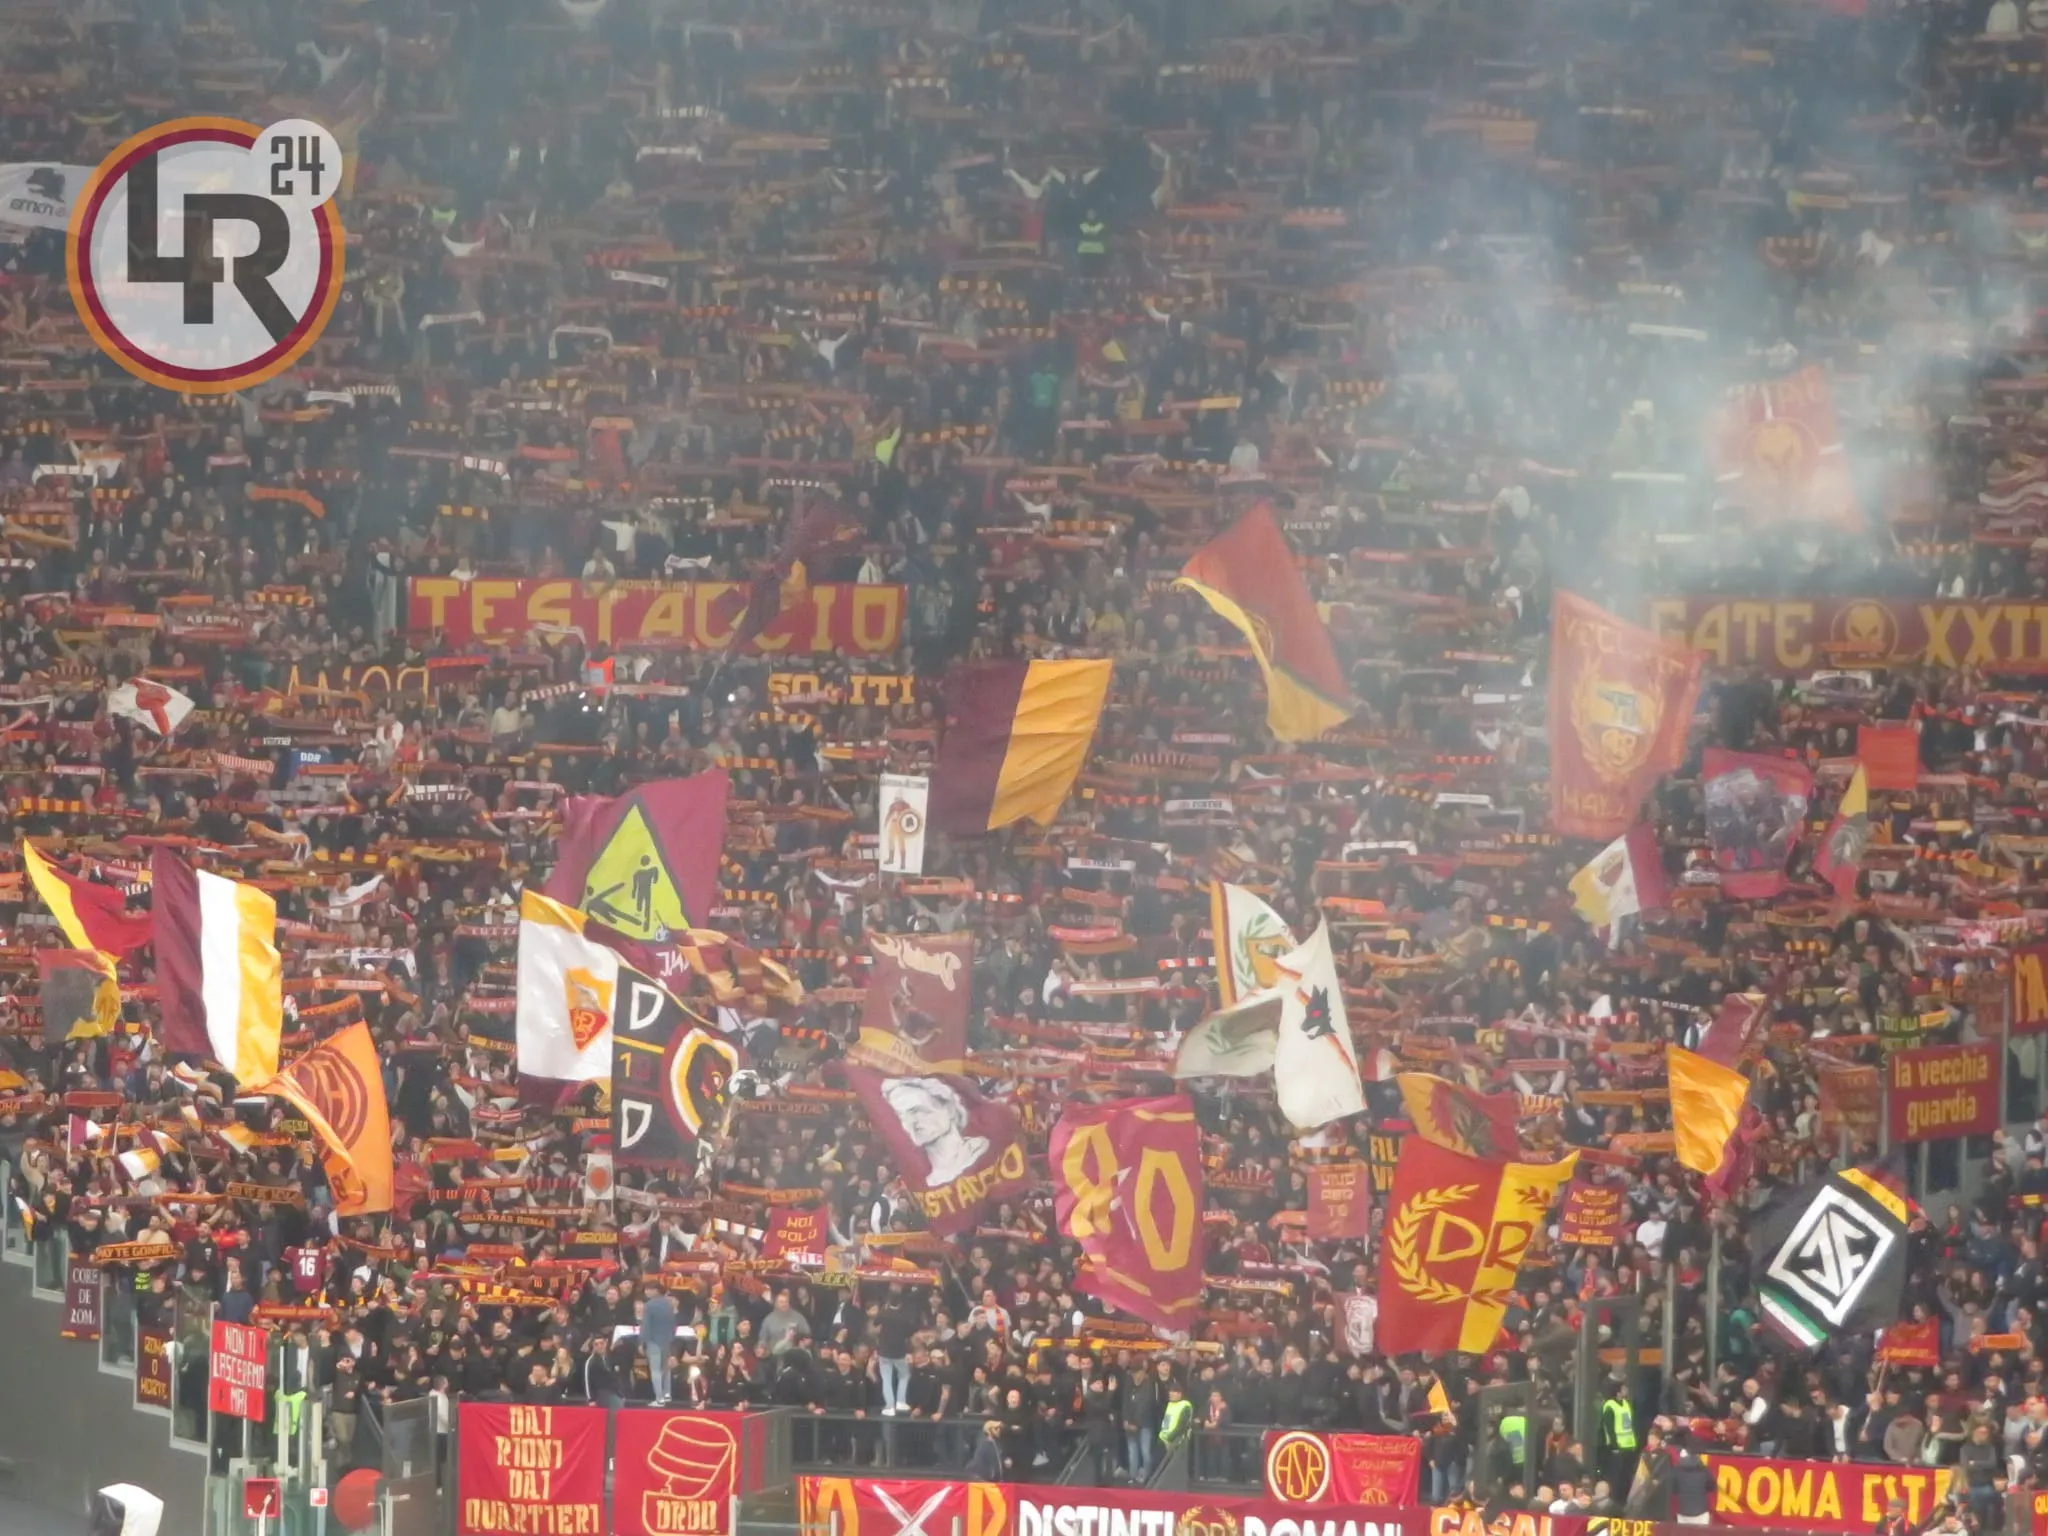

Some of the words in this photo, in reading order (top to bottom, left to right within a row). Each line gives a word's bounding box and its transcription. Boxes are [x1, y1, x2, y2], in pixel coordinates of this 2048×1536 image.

[767, 673, 917, 706] SOITI
[1896, 1054, 1911, 1088] la
[1919, 1050, 1988, 1087] vecchia
[1907, 1090, 1977, 1136] guardia
[299, 1257, 316, 1276] 16
[79, 1288, 91, 1304] DE
[225, 1325, 245, 1355] NON
[248, 1330, 256, 1359] TI
[213, 1351, 265, 1390] LASCEREMO
[230, 1387, 248, 1416] MAI
[508, 1406, 552, 1435] DAI
[495, 1436, 562, 1470] RIONI
[508, 1469, 550, 1500] DAI
[1715, 1464, 1842, 1520] ROMA
[1862, 1473, 1926, 1523] EST
[465, 1499, 600, 1535] QUARTIERI
[1020, 1500, 1174, 1536] DISTINTI
